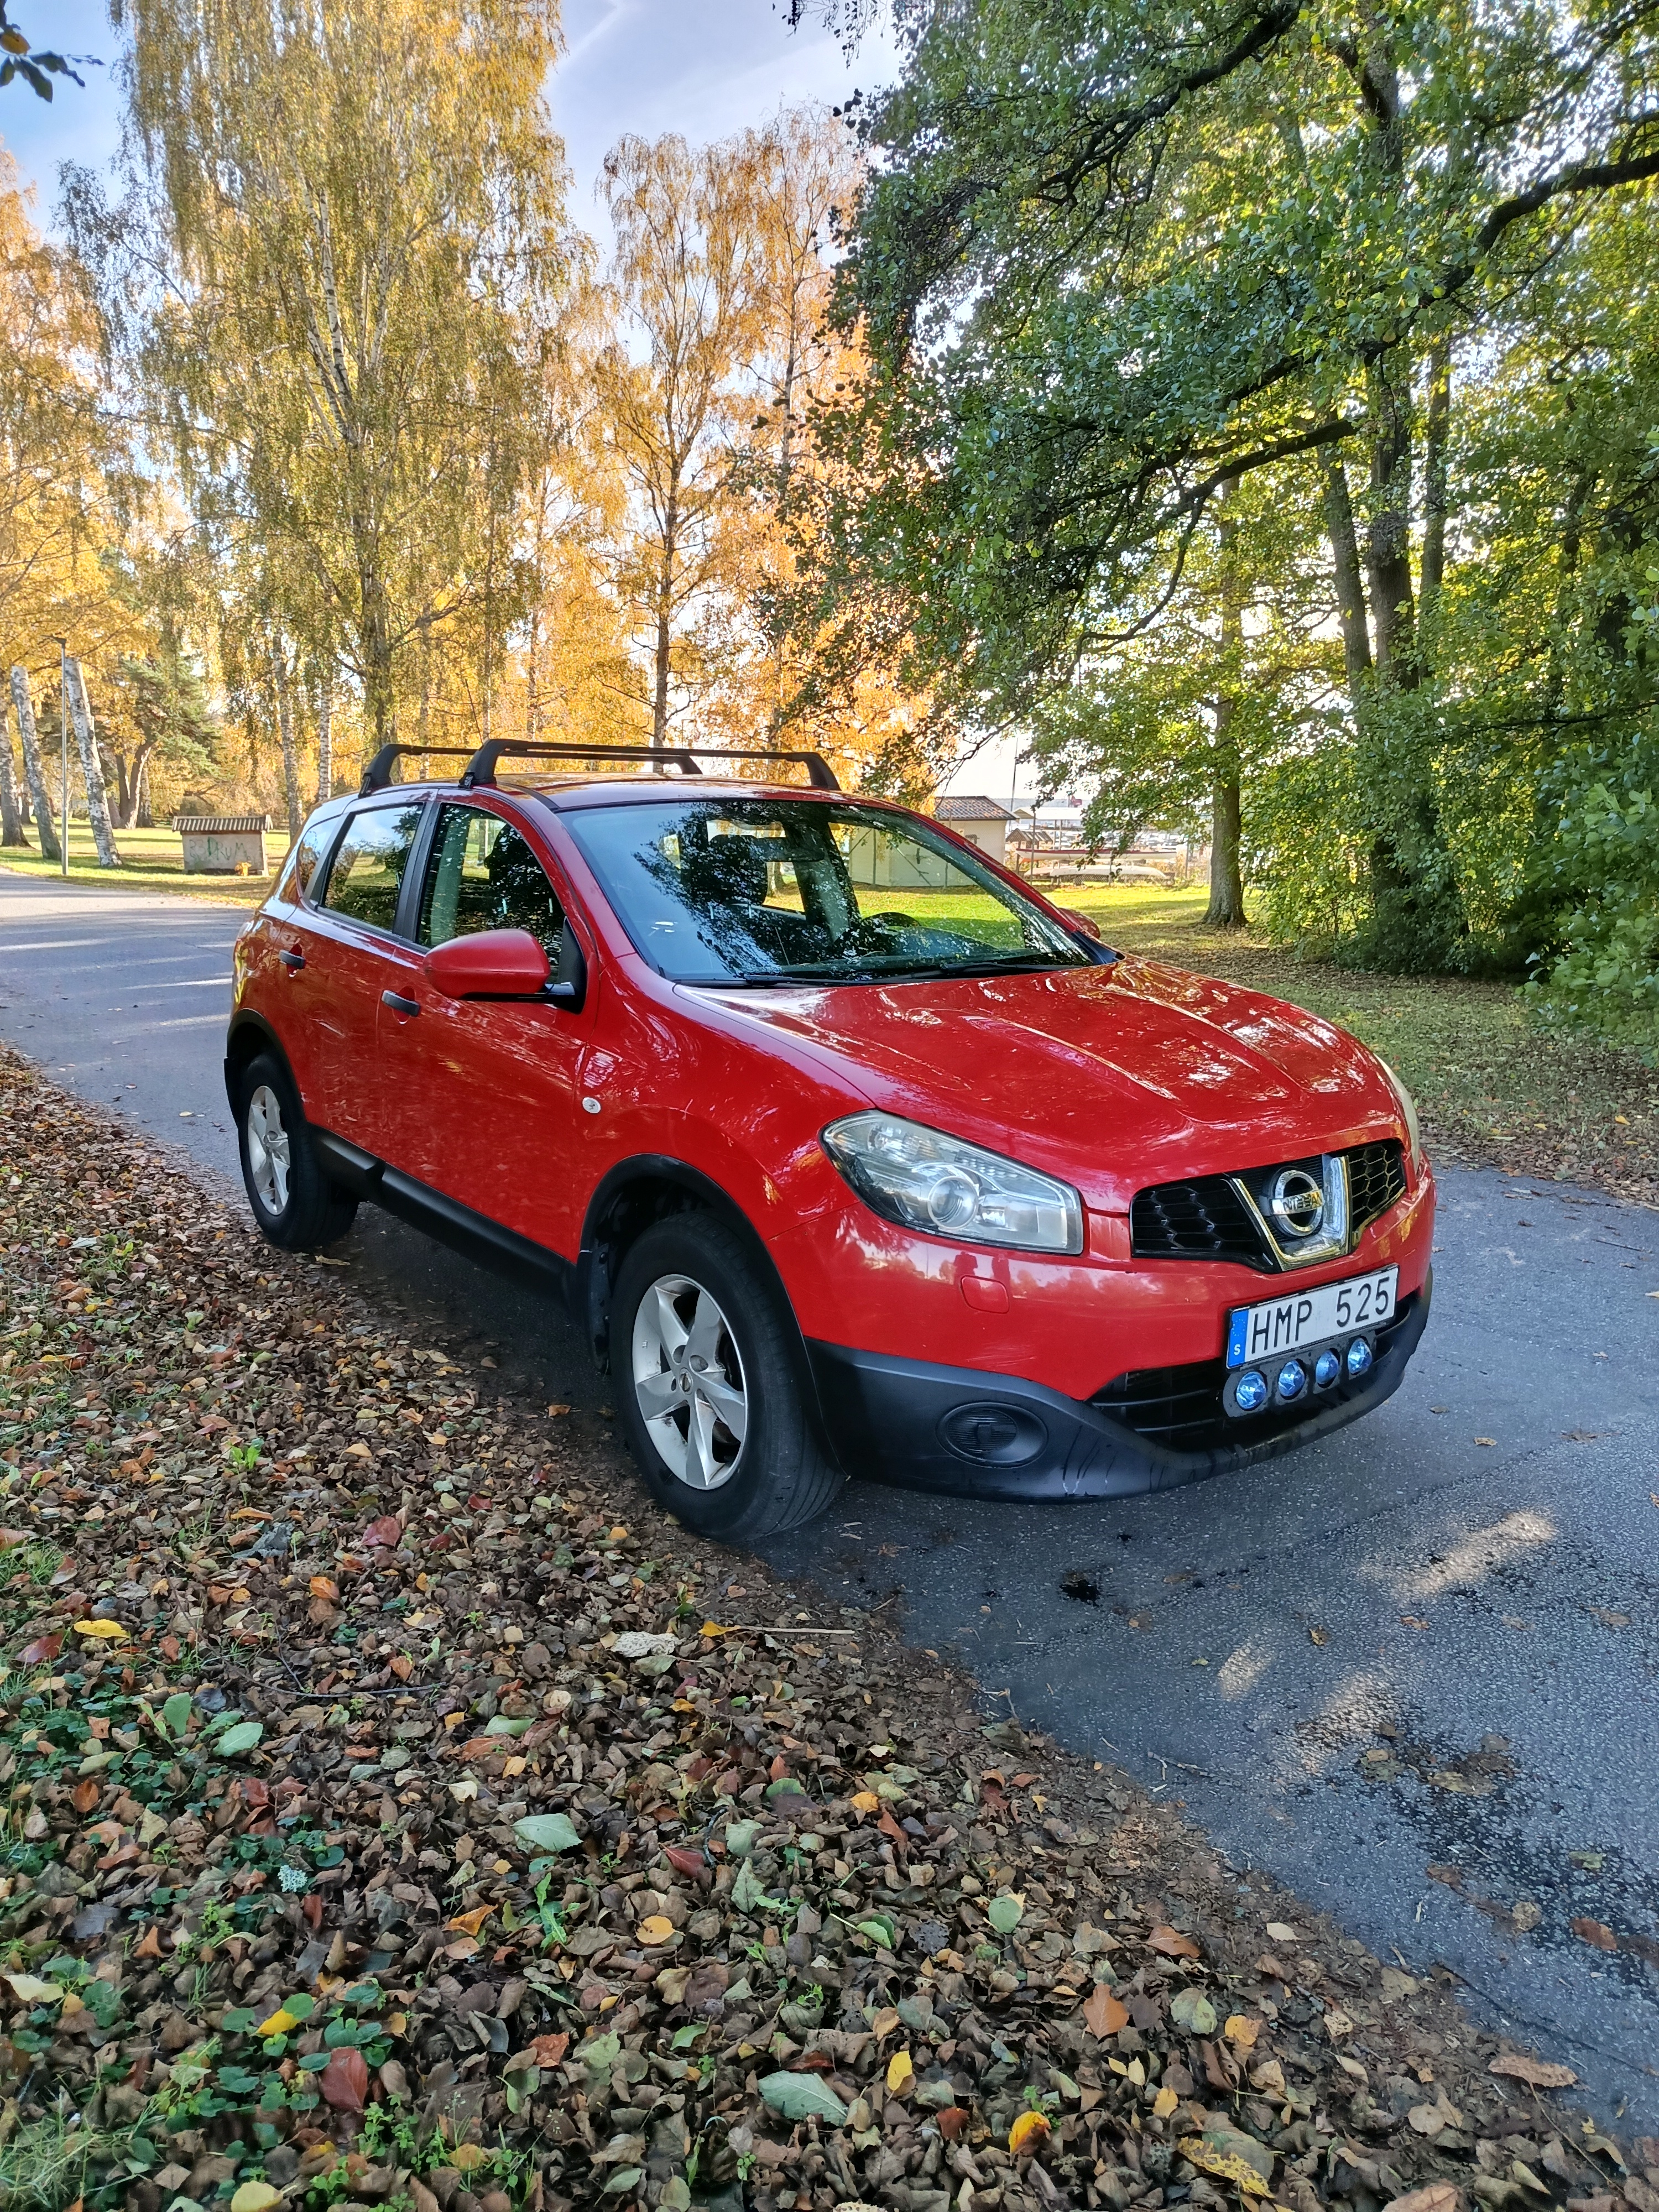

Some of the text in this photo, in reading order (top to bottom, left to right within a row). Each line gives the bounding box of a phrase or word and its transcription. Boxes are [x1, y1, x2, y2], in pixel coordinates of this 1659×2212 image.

[1283, 1191, 1323, 1212] NISSAN
[1251, 1276, 1390, 1354] HMP 525
[1234, 1344, 1241, 1355] S
